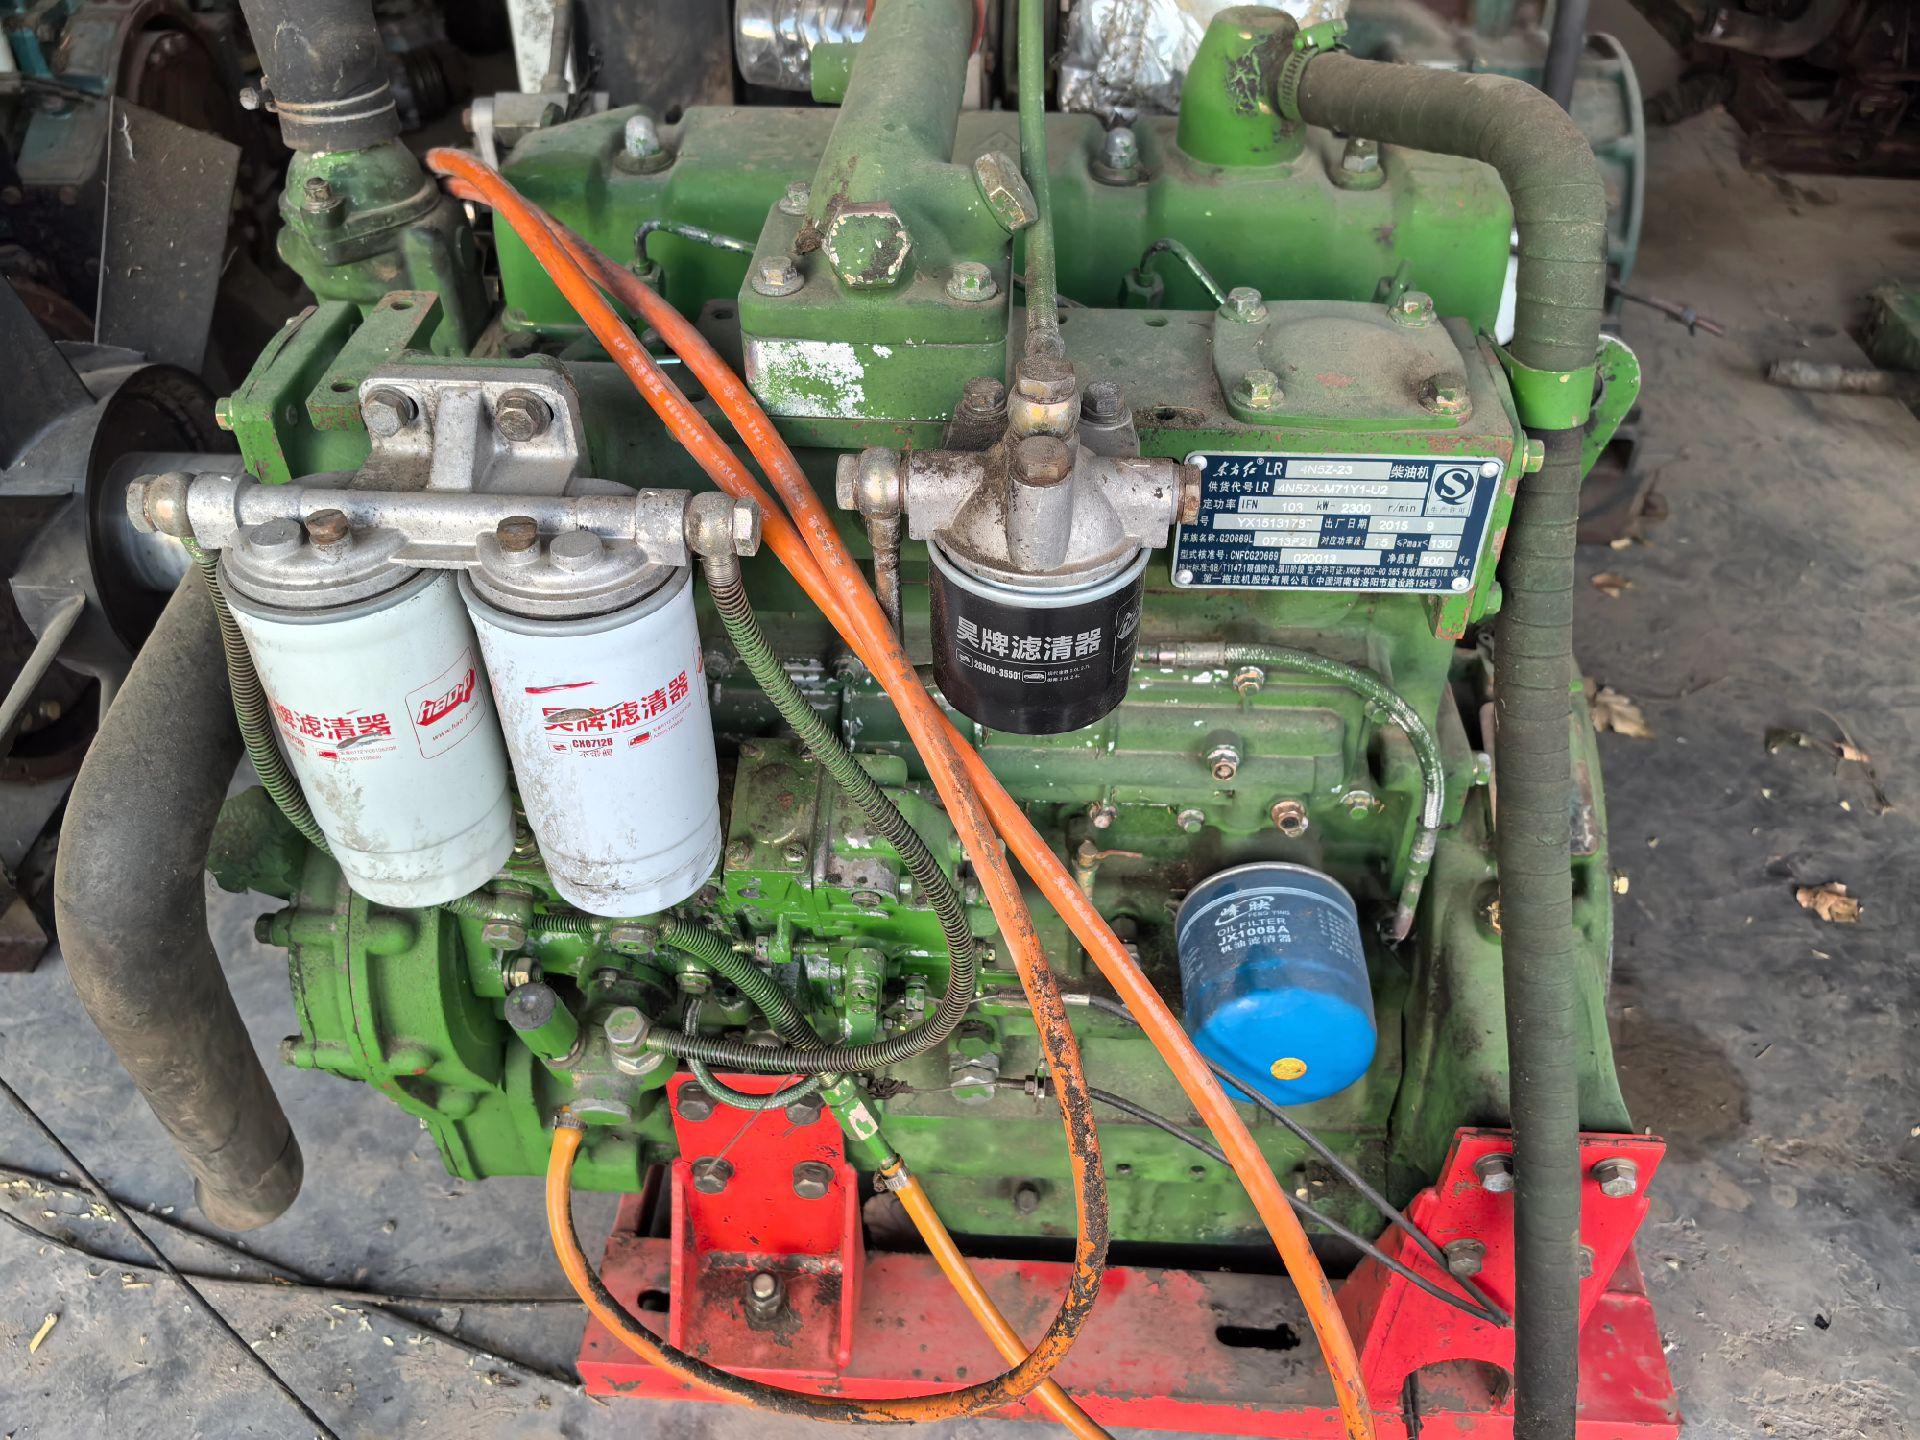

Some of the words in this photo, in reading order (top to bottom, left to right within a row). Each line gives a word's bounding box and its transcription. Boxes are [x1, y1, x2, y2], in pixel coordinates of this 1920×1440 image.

[1265, 462, 1283, 476] LR
[1390, 465, 1429, 480] 柴油机
[1202, 498, 1237, 510] 定功率
[1281, 502, 1303, 512] 103
[1341, 503, 1372, 514] 2300
[1387, 503, 1417, 513] r/min
[1324, 517, 1368, 530] 出厂日期
[1379, 520, 1409, 531] 2015
[1431, 539, 1453, 549] 130
[1458, 555, 1471, 566] Kg
[1217, 924, 1237, 937] OIL
[1240, 917, 1287, 929] FILTER
[1218, 925, 1290, 947] JX1008A
[1220, 934, 1292, 955] 机油滤清器
